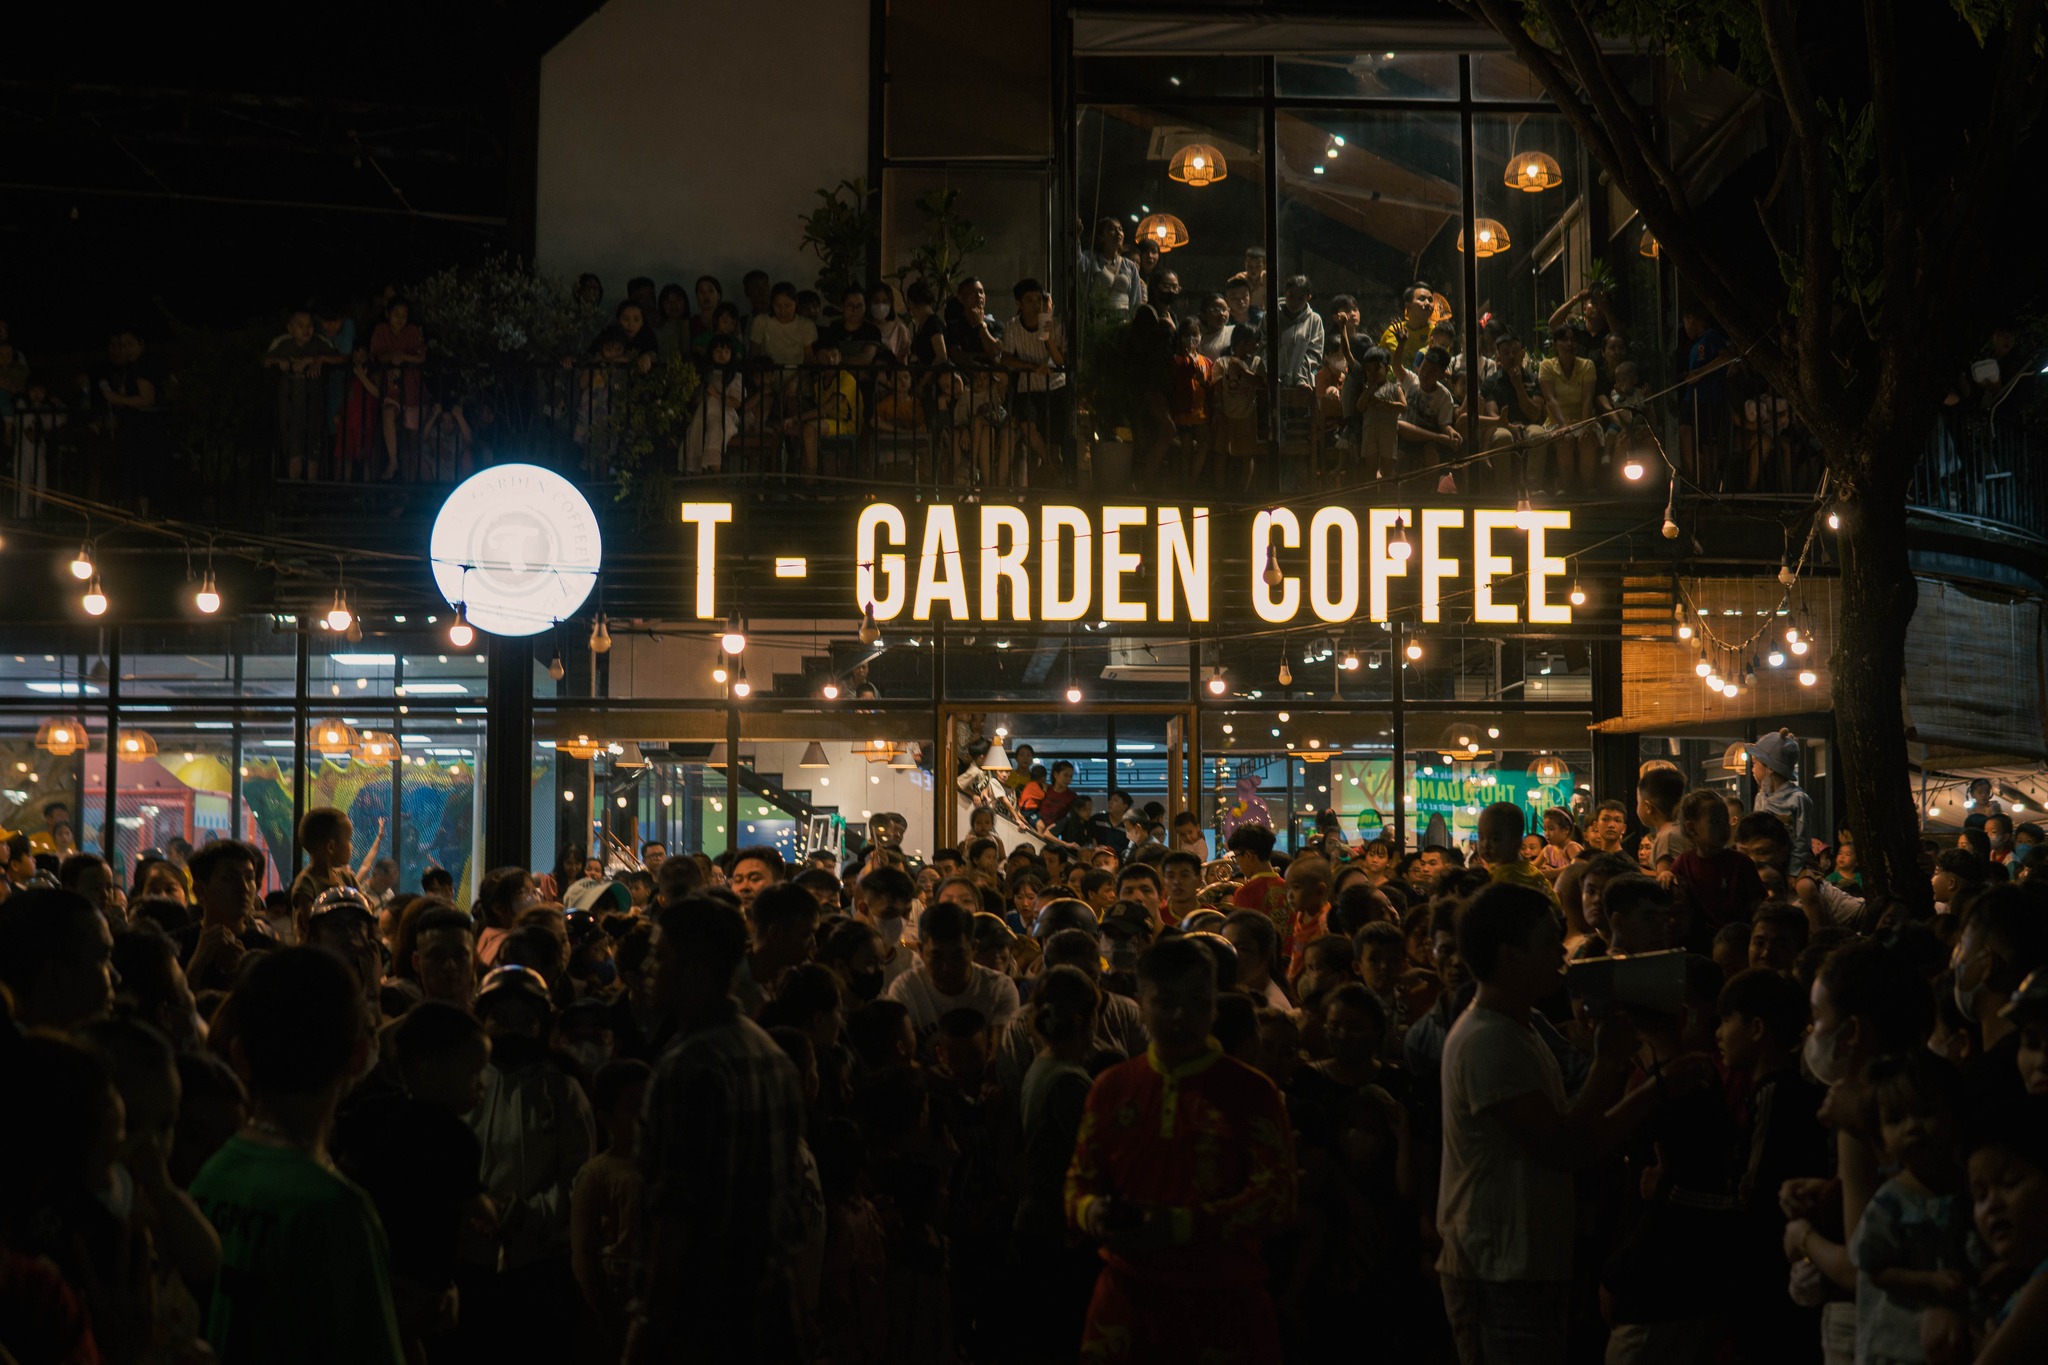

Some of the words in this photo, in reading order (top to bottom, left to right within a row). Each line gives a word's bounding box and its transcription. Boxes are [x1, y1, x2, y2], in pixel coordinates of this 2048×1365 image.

[681, 502, 732, 619] T
[856, 502, 1210, 621] GARDEN
[1252, 505, 1572, 623] COFFEE
